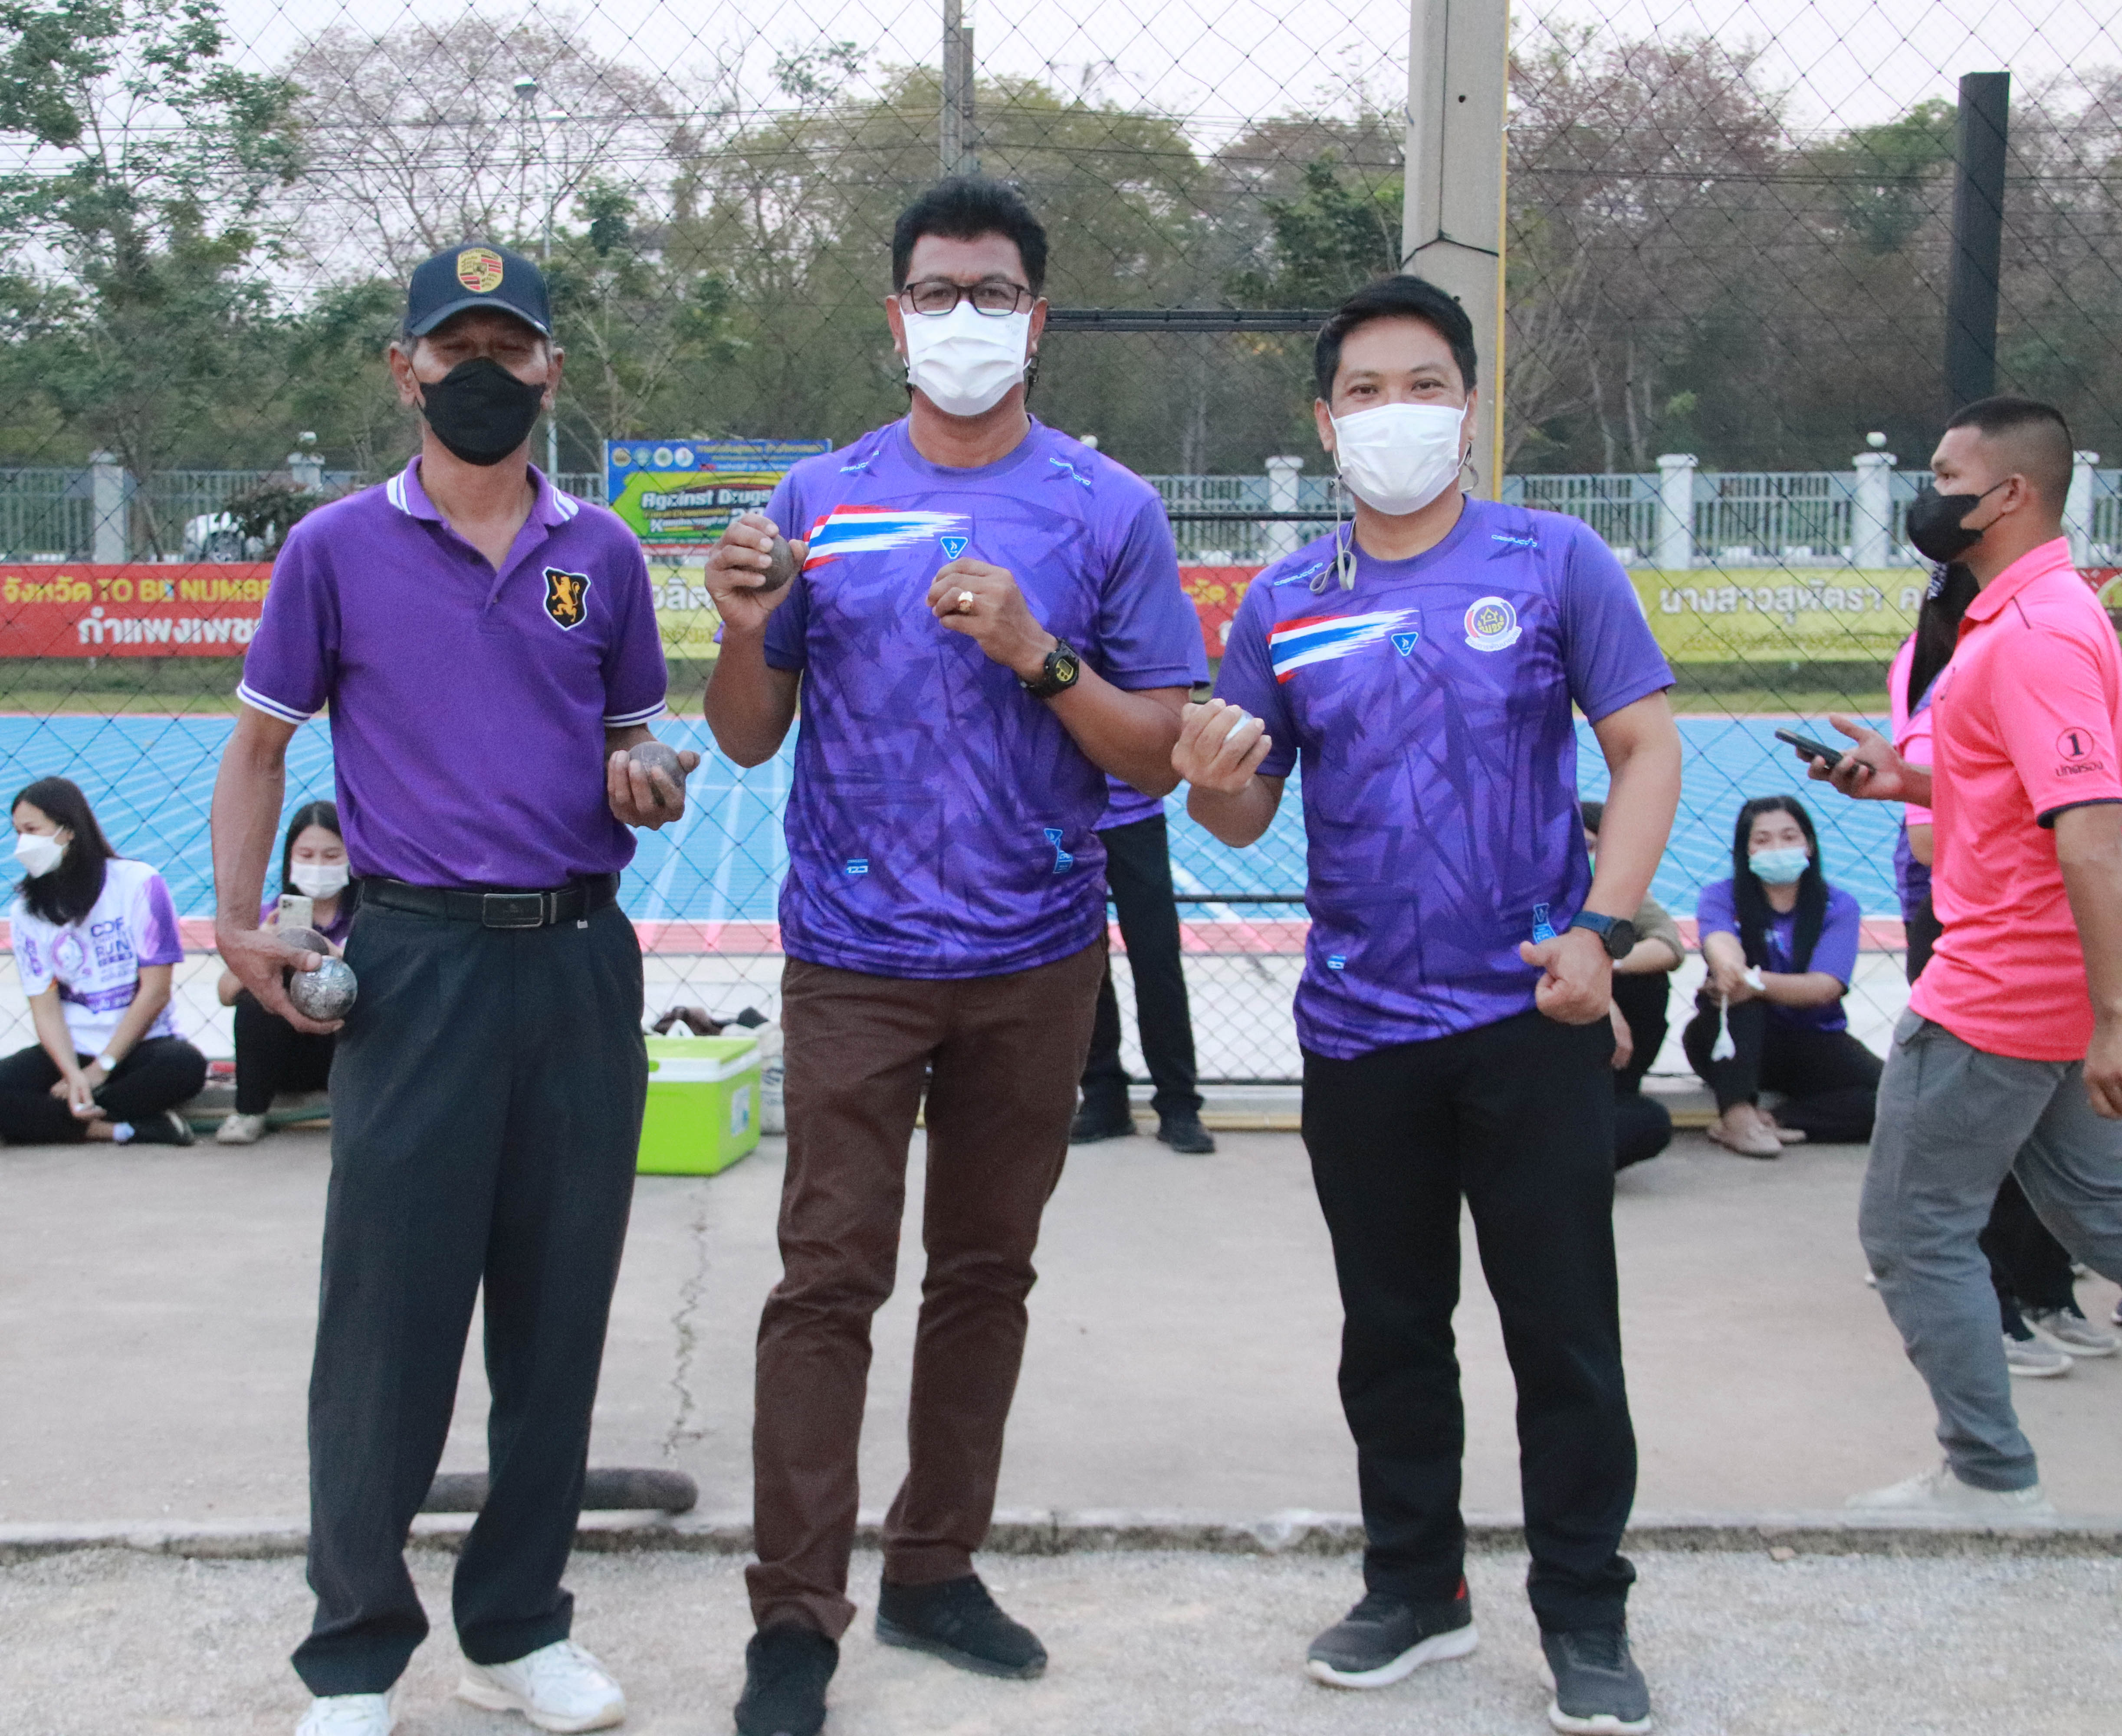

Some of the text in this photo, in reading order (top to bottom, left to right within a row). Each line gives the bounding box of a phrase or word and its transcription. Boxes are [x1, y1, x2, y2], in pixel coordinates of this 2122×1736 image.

[96, 578, 134, 602] TO
[78, 605, 261, 644] กำแพงเพช
[2067, 733, 2084, 756] 1
